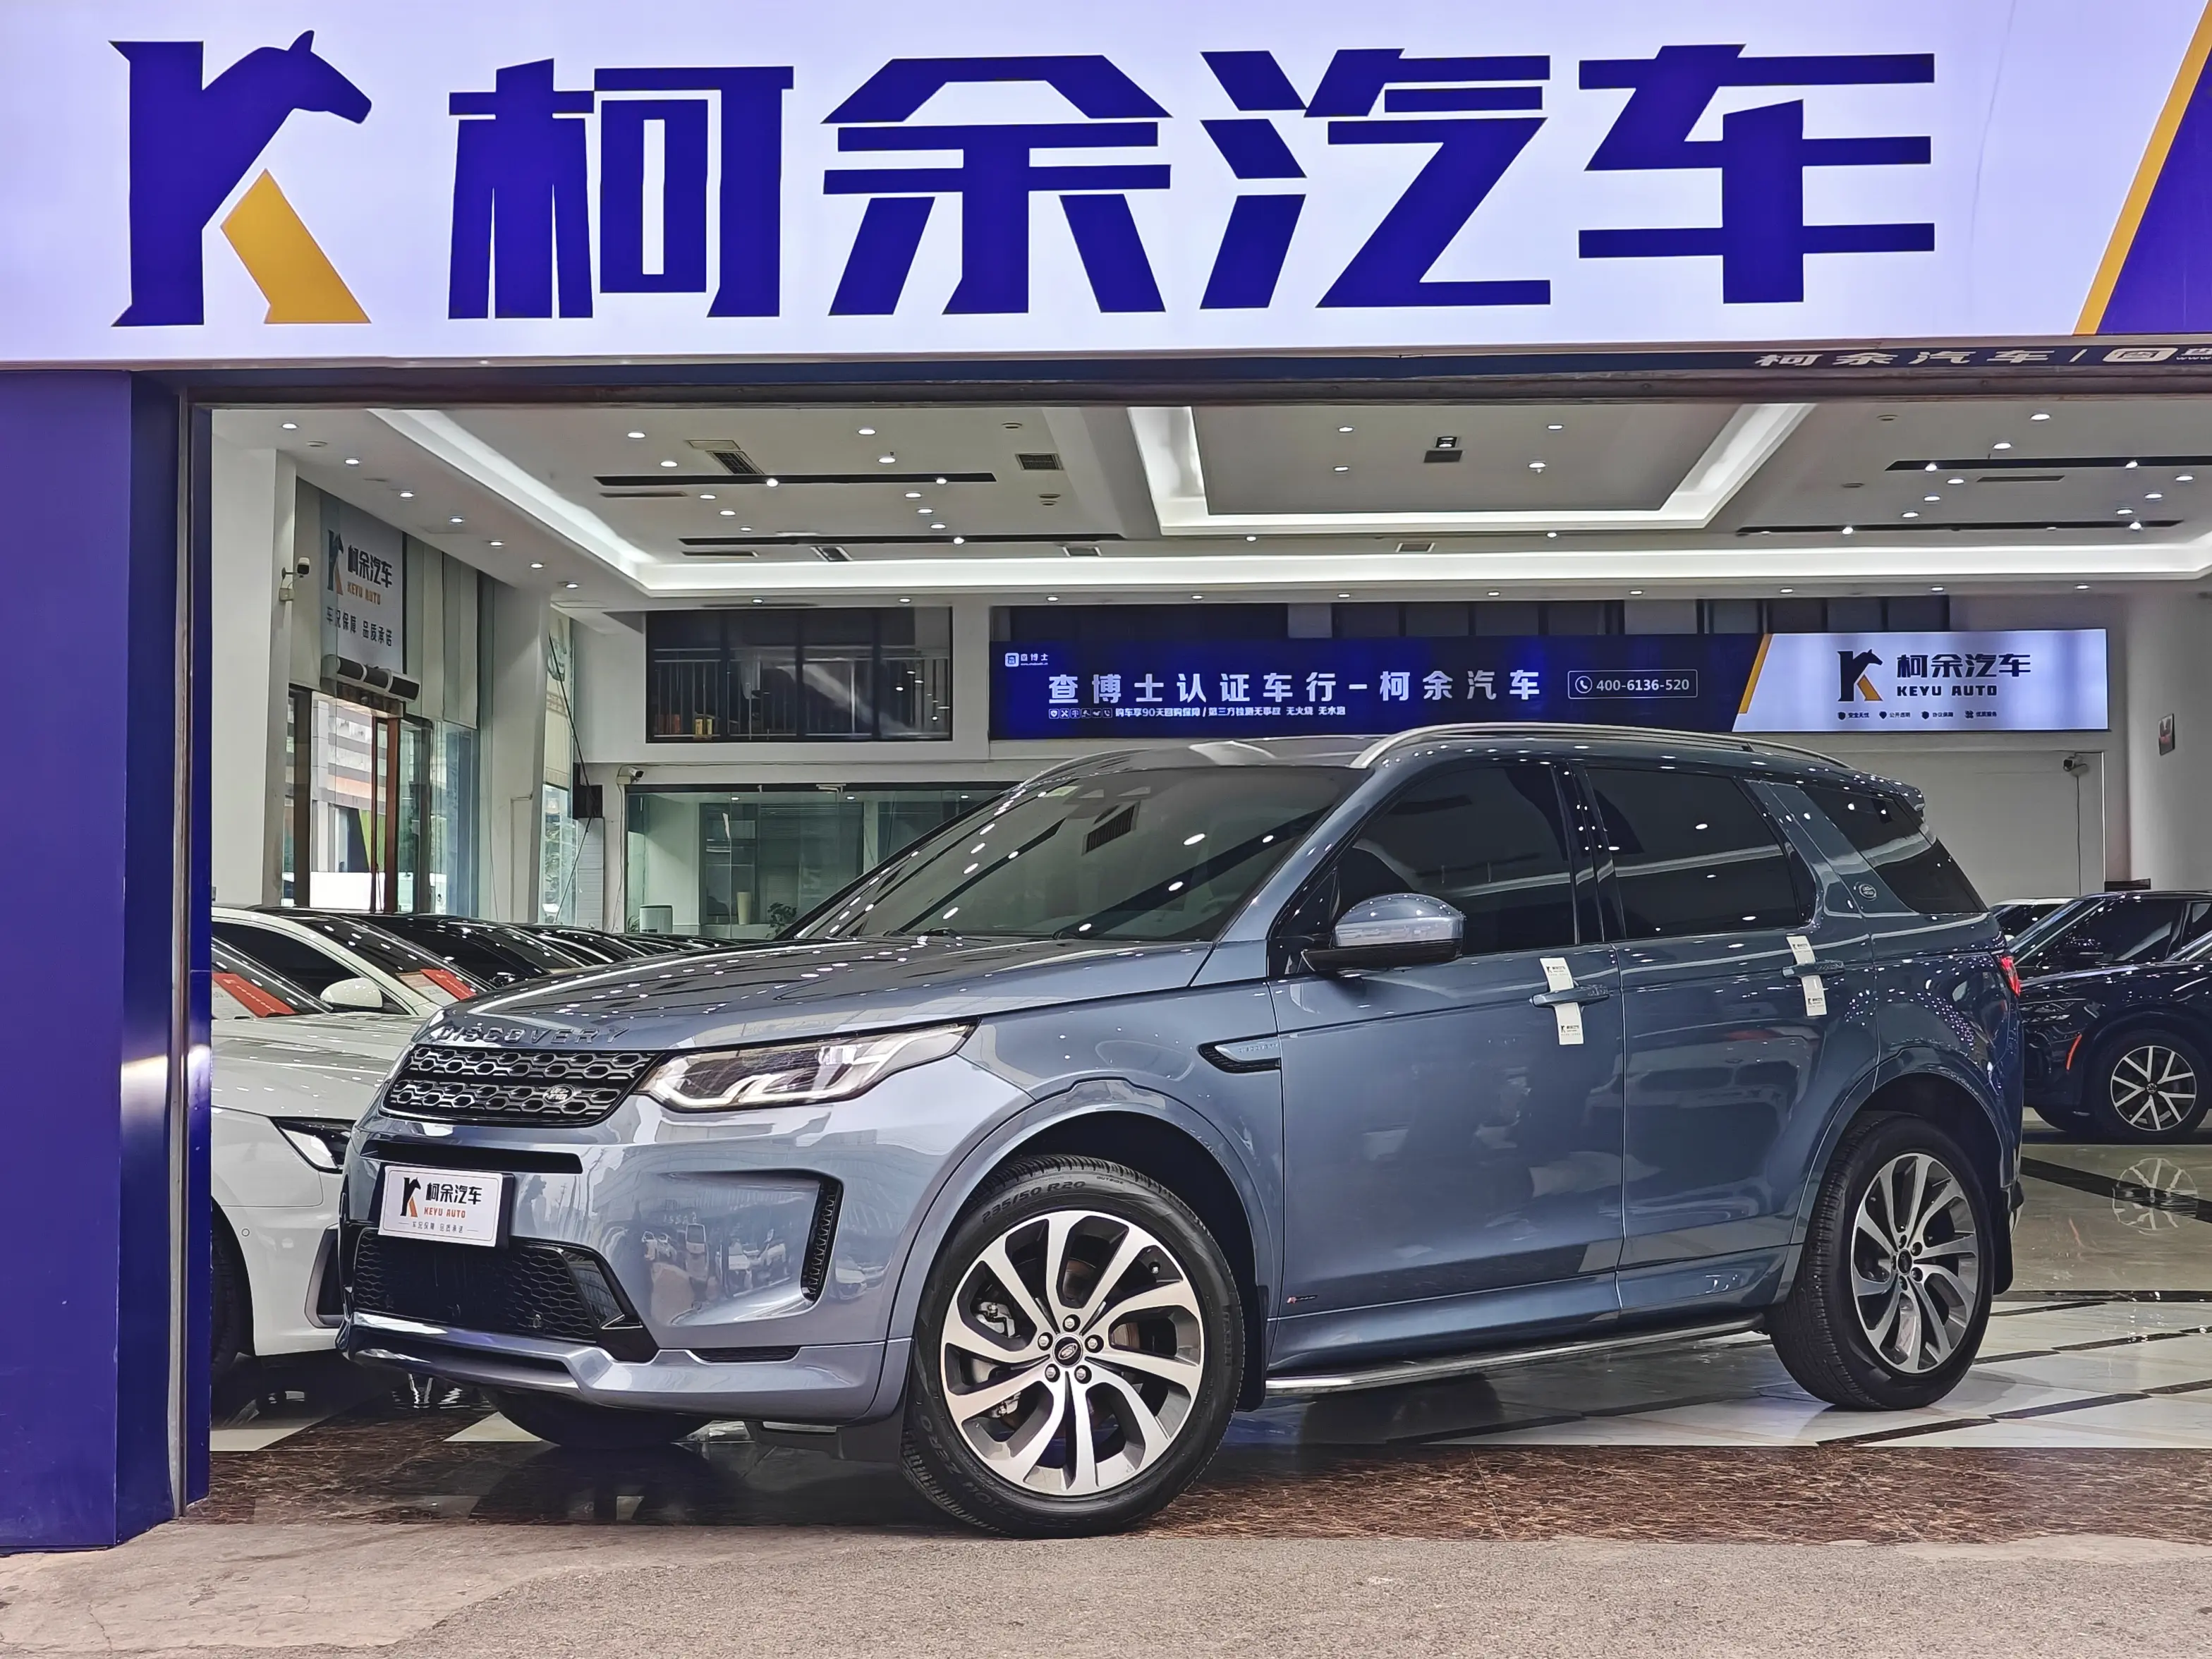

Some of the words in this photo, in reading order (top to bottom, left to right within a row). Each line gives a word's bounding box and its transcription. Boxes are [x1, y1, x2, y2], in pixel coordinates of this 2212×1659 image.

[447, 44, 1936, 320] 柯余汽车
[1755, 350, 2055, 367] 柯余汽车
[347, 545, 393, 588] 柯余汽车
[1896, 653, 2031, 678] 柯余汽车
[1596, 679, 1689, 691] 400-6136-520
[1897, 685, 1942, 696] KEYU
[1951, 685, 1997, 696] AUTO
[437, 1026, 629, 1044] DISCOVERY
[425, 1182, 483, 1205] 柯余汽车
[981, 1186, 1043, 1224] 235/50
[1047, 1181, 1086, 1192] R20
[424, 1207, 443, 1216] KEYU
[446, 1209, 466, 1219] AUTO
